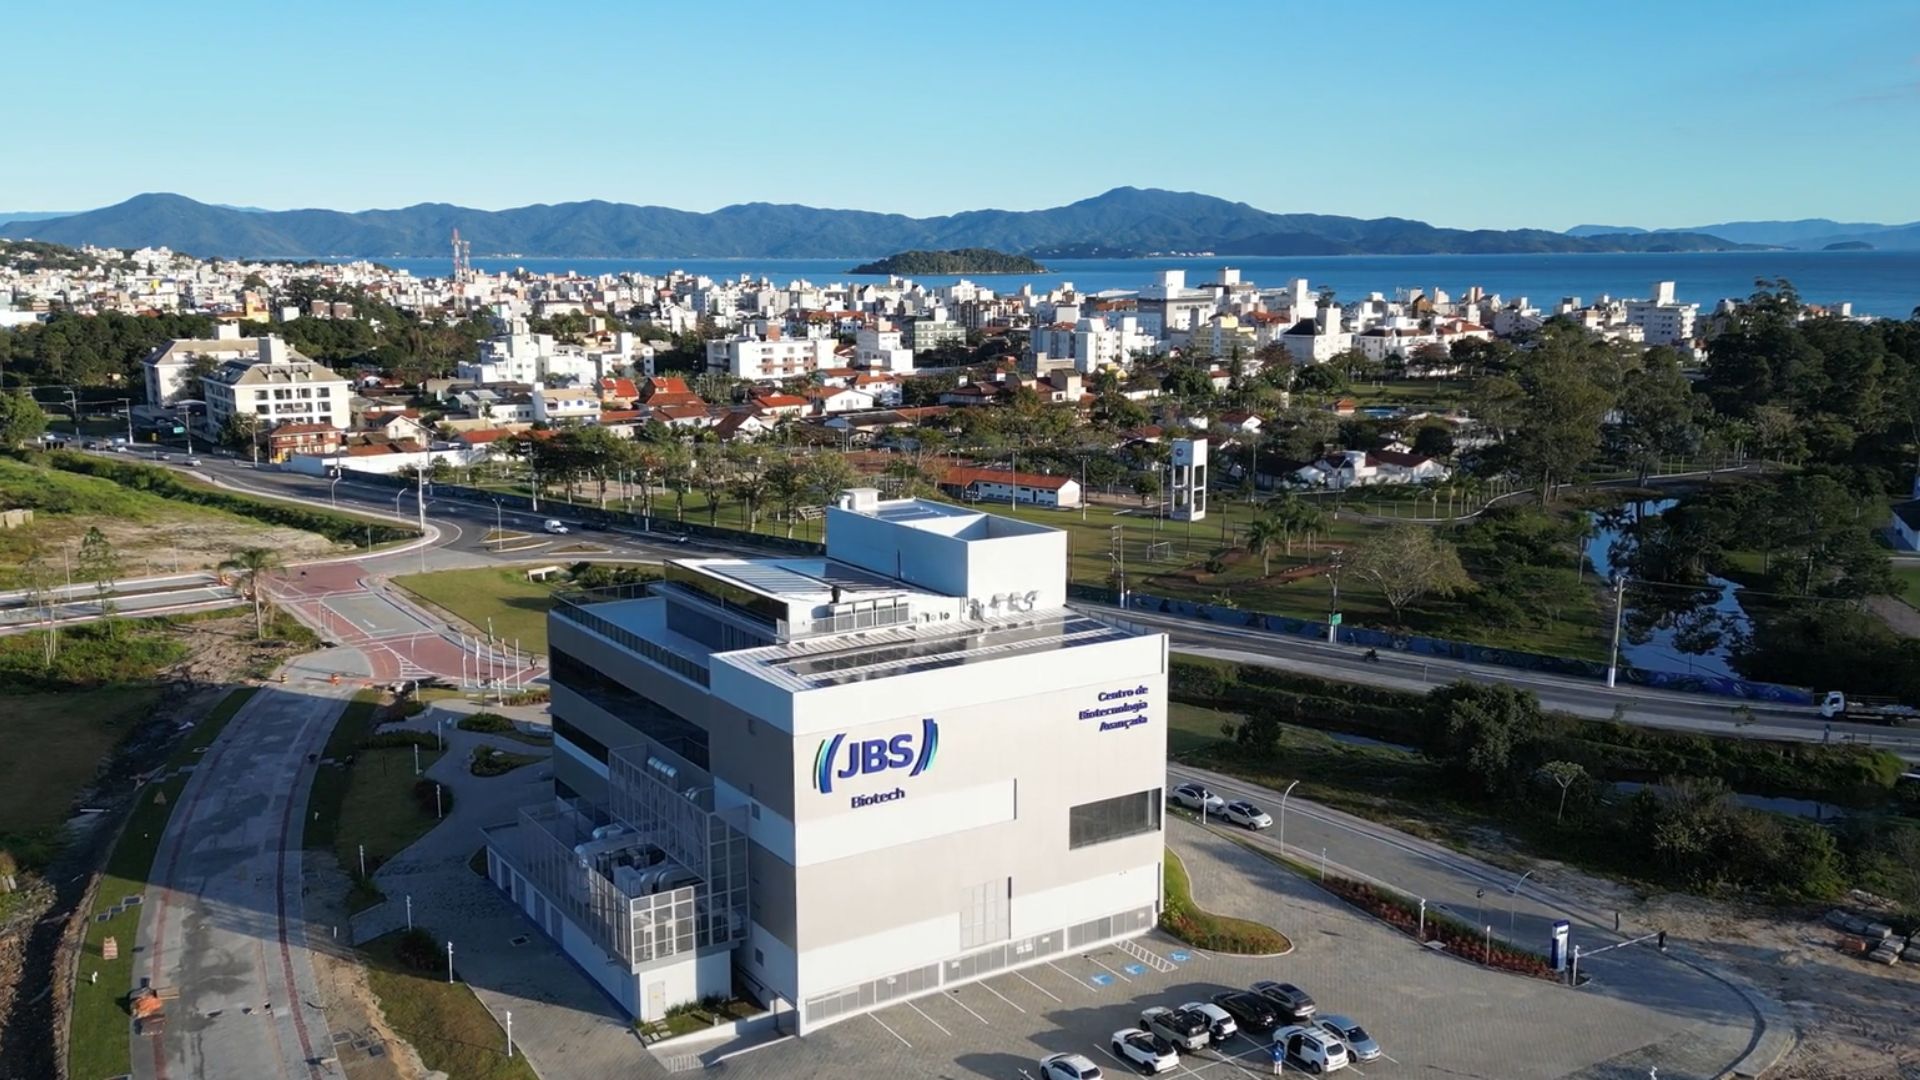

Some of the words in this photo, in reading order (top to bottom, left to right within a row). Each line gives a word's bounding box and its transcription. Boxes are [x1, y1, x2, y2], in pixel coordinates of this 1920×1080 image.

[1098, 690, 1134, 702] Centro
[1135, 685, 1149, 695] de
[1079, 700, 1148, 720] Biotecnologia
[1099, 715, 1148, 732] Avançada
[837, 733, 914, 779] JBS
[851, 787, 905, 808] Biotech
